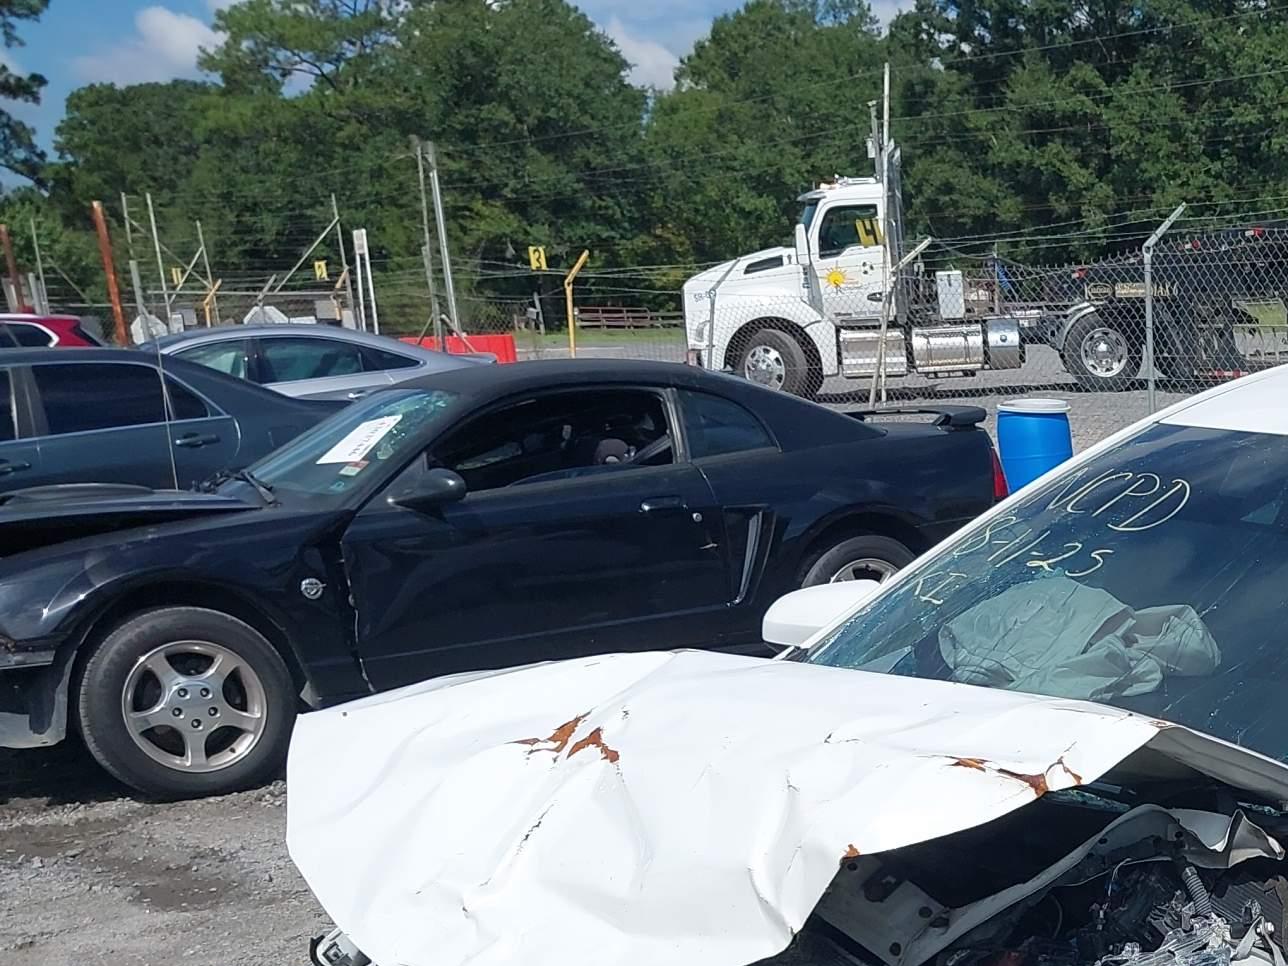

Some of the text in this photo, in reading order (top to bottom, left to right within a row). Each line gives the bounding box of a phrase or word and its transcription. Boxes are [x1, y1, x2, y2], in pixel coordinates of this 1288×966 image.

[862, 219, 879, 246] 4
[532, 248, 543, 270] 3
[1021, 467, 1191, 532] NCPD
[953, 515, 1115, 577] 8-11-25
